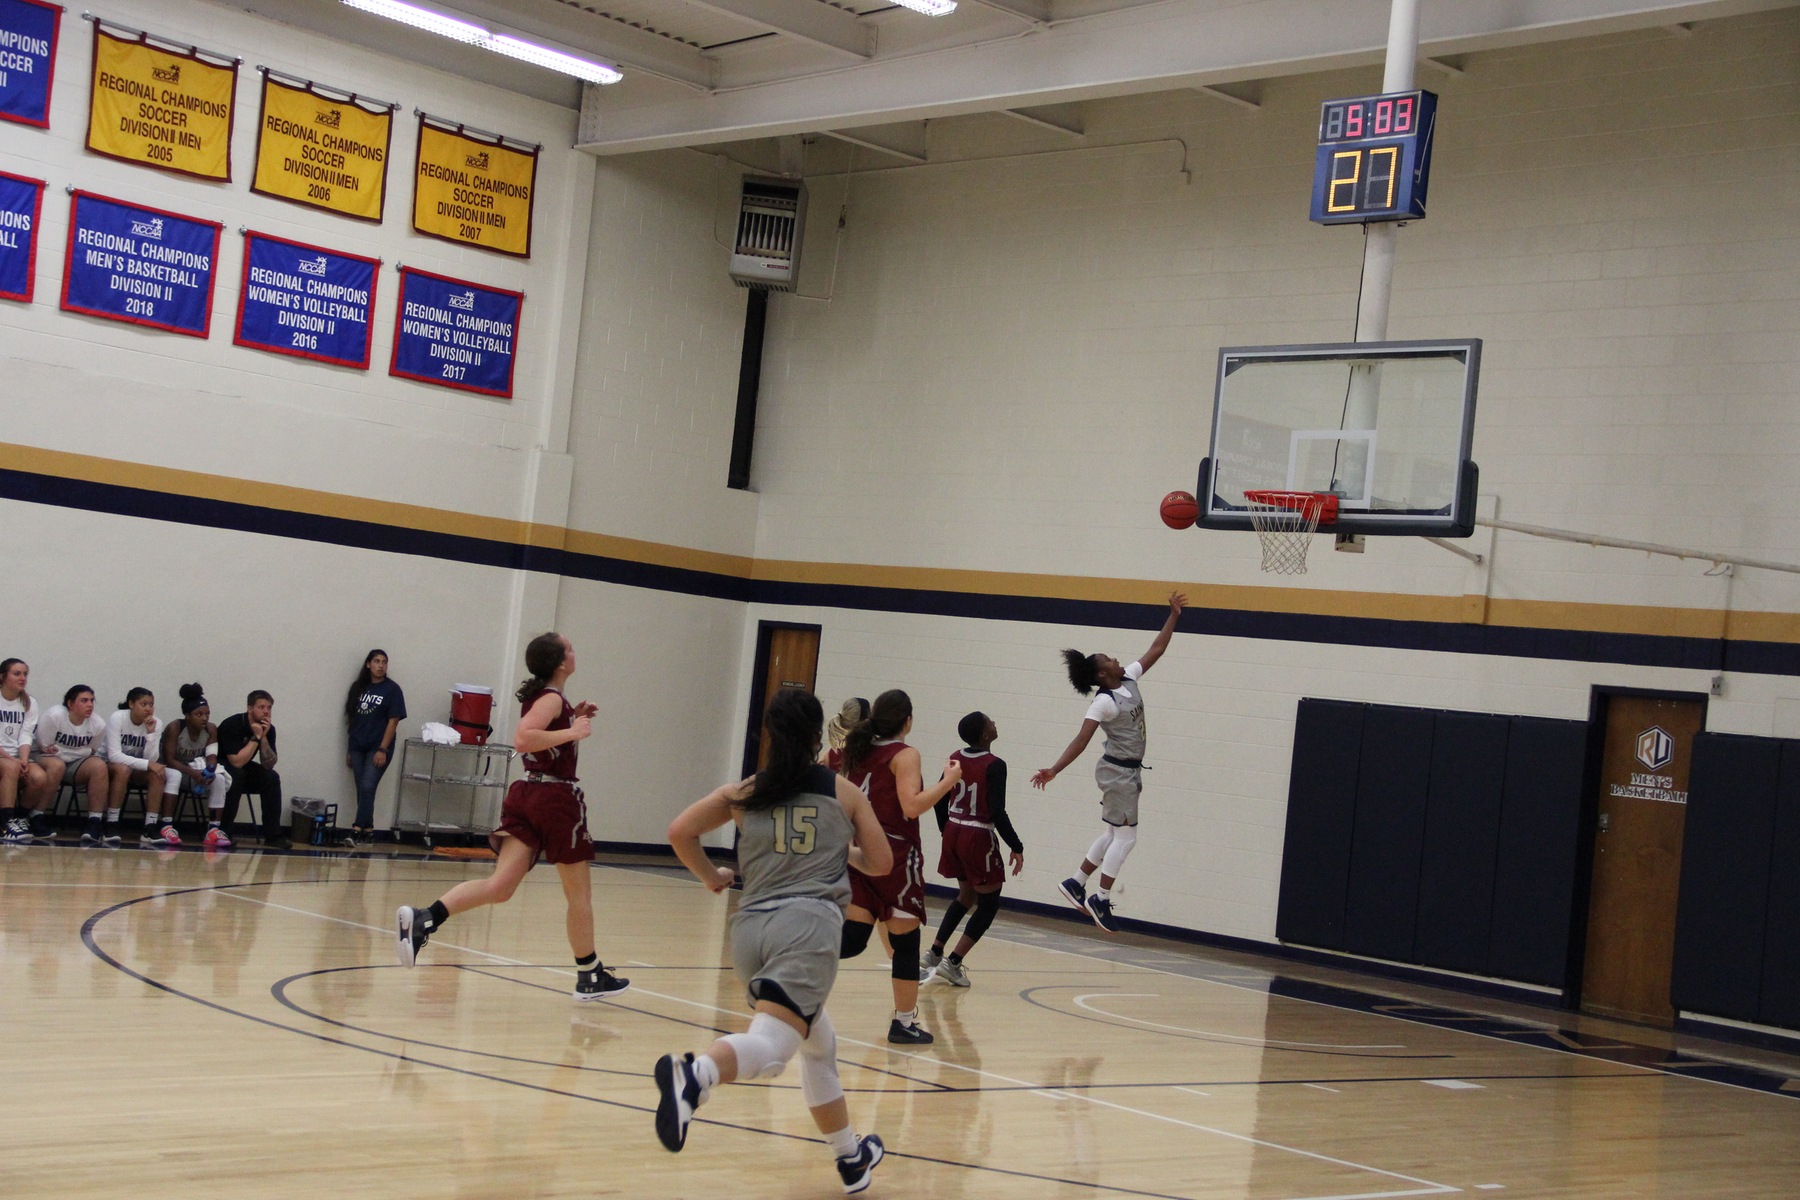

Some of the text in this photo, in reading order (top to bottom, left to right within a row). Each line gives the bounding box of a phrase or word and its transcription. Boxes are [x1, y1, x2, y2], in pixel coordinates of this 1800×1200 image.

[100, 72, 227, 119] REGIONAL CHAMPIONS
[139, 103, 187, 128] SOCCER
[120, 116, 169, 142] DIVISION
[178, 132, 201, 151] MEN
[266, 115, 383, 162] REGIONAL CHAMPIONS
[147, 143, 173, 163] 2005
[301, 144, 345, 170] SOCCER
[284, 157, 329, 184] DIVISION
[336, 170, 359, 191] MEN
[420, 161, 529, 200] REGIONAL CHAMPIONS
[1328, 147, 1398, 212] 27
[308, 184, 331, 202] 2006
[453, 187, 494, 209] SOCCER
[437, 201, 478, 223] DIVISION
[486, 212, 506, 229] MEN
[460, 223, 482, 241] 2007
[78, 227, 209, 272] REGIONAL CHAMPIONS
[86, 249, 198, 289] MEN'S BASKETBALL
[110, 274, 172, 301] DIVISION II
[251, 266, 368, 306] REGIONAL CHAMPIONS
[125, 297, 154, 317] 2018
[249, 284, 367, 324] WOMEN'S VOLLEYBALL
[405, 301, 512, 338] REGIONAL CHAMPIONS
[278, 310, 335, 335] DIVISION II
[403, 318, 511, 355] WOMEN'S VOLLEYBALL
[292, 332, 318, 350] 2016
[430, 343, 482, 367] DIVISION II
[442, 363, 466, 381] 2017
[55, 731, 93, 748] FAMILY
[1640, 731, 1670, 766] RU
[1631, 773, 1672, 789] MEN'S
[949, 779, 977, 817] 21
[771, 805, 818, 855] 15
